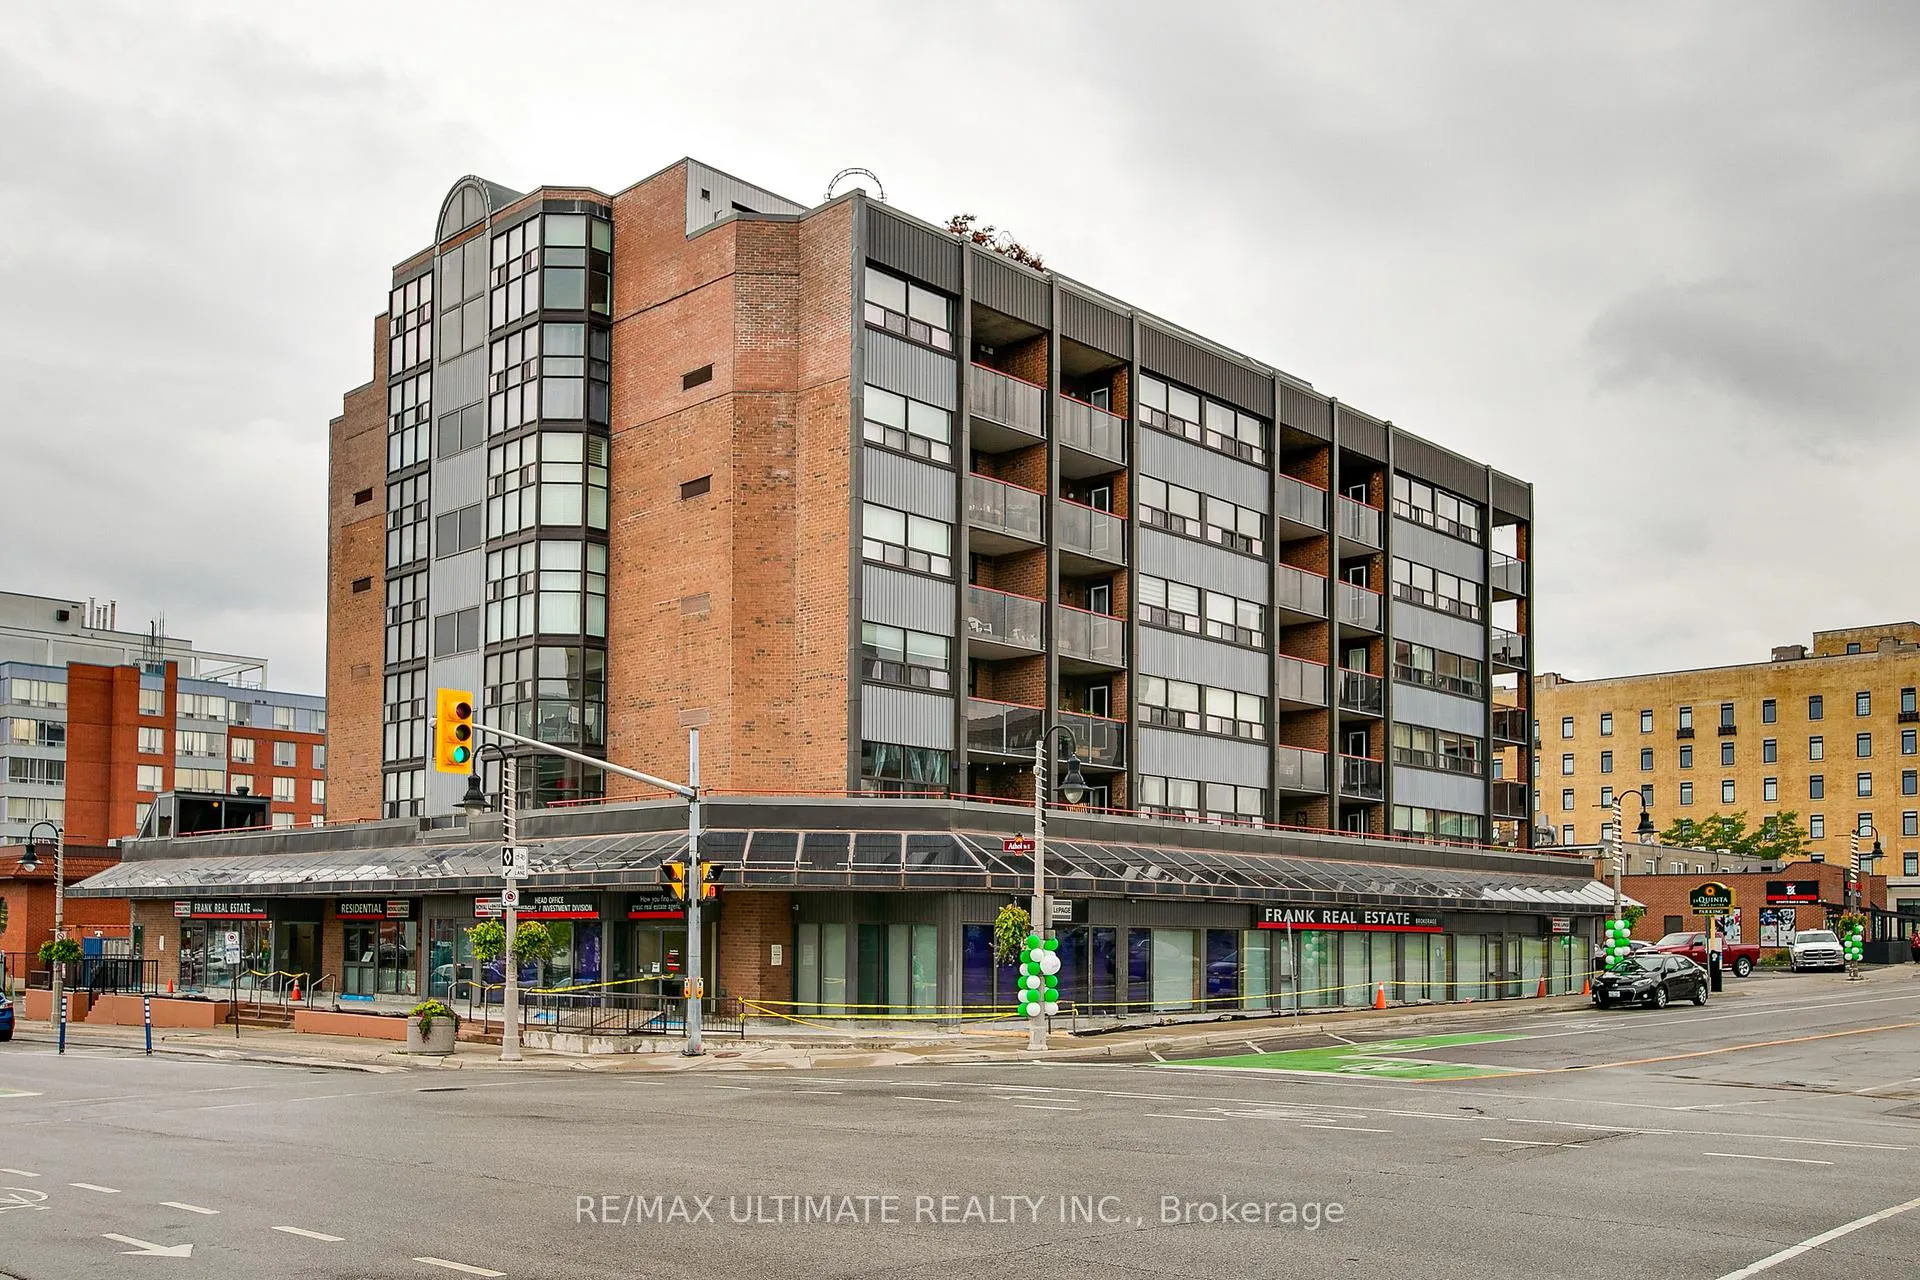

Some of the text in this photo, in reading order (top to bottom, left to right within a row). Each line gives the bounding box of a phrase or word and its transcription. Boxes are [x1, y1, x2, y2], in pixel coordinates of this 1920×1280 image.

[1008, 842, 1022, 850] Athol
[534, 896, 564, 904] HEAD OFFICE
[1698, 896, 1728, 905] QUINTA
[194, 903, 213, 913] FRANK
[214, 903, 228, 913] REAL
[230, 903, 251, 913] ESTATE
[341, 903, 383, 914] RESIDENTIAL
[542, 904, 571, 912] INVESTMENT
[571, 904, 593, 912] DIVISION
[1265, 908, 1316, 923] FRANK
[1322, 910, 1358, 924] REAL
[1364, 911, 1411, 925] ESTATE
